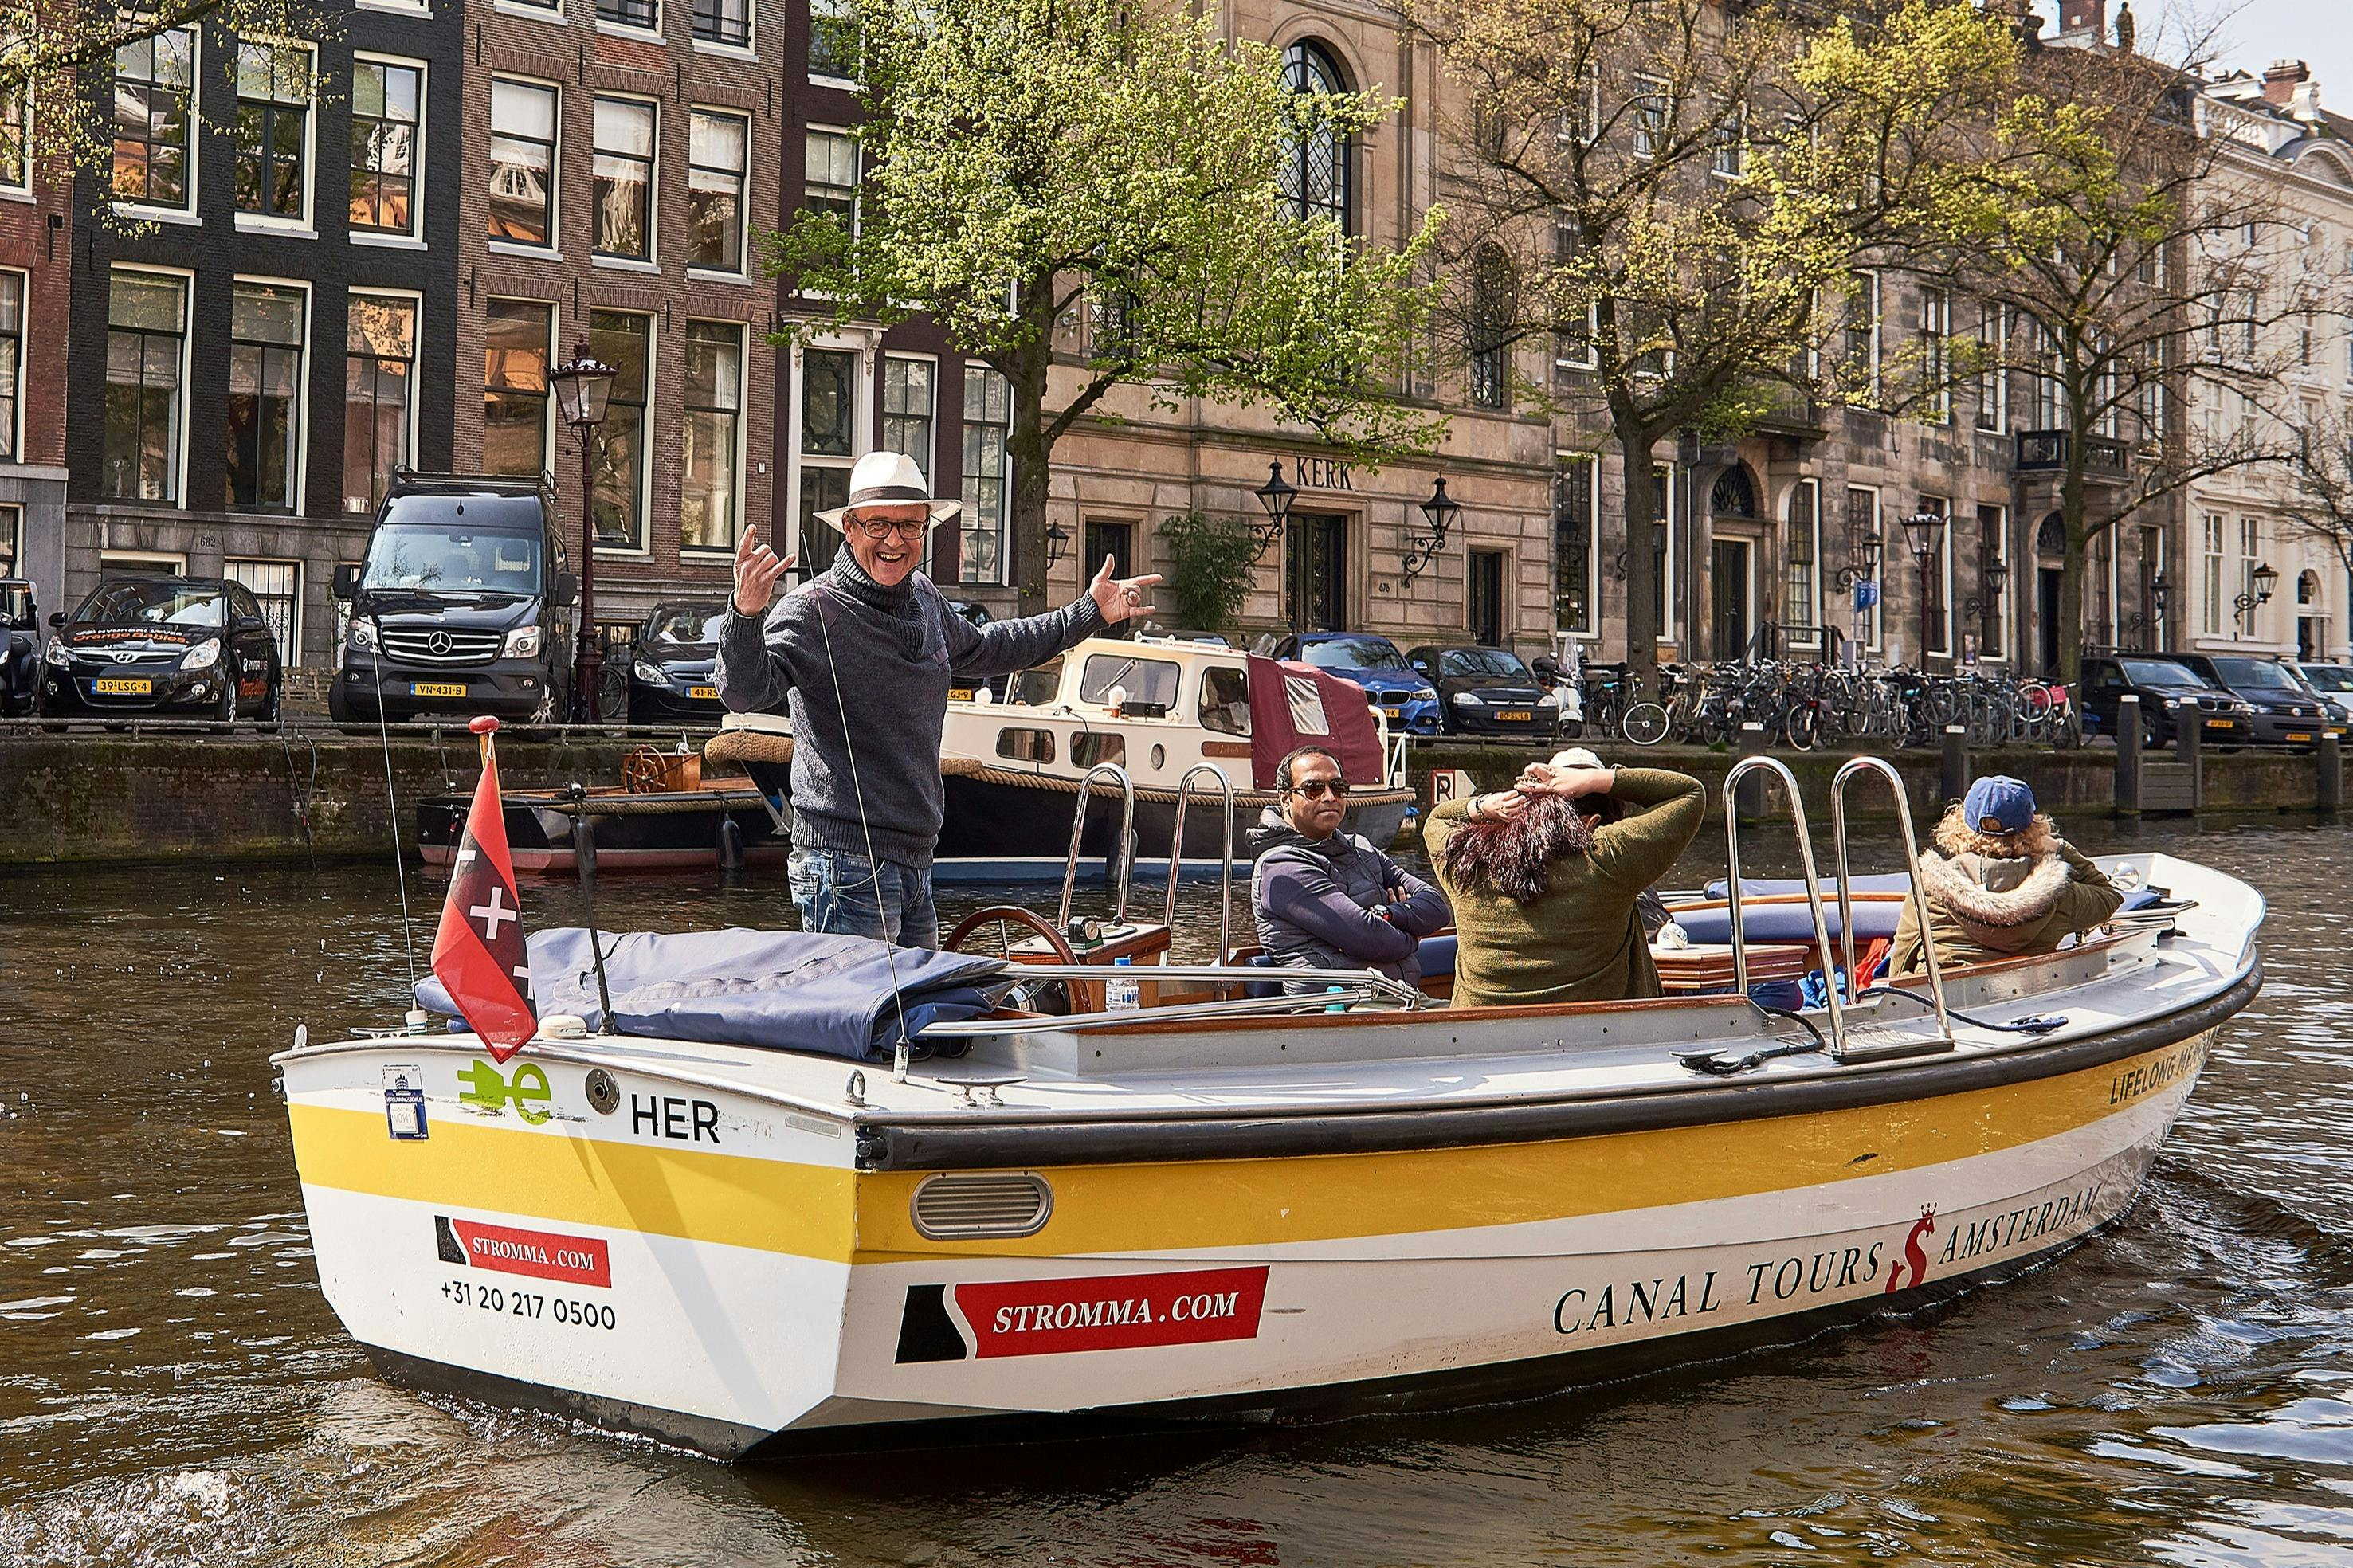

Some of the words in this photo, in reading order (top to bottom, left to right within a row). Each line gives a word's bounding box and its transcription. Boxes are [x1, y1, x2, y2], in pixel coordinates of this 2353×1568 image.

[1296, 457, 1352, 491] KERK
[200, 535, 216, 547] 682
[73, 632, 131, 642] Orange
[100, 680, 147, 691] 39-LSG-4
[419, 684, 462, 696] VN-431-B
[694, 688, 719, 697] 41-RS
[950, 690, 969, 699] GJ-9
[2110, 1053, 2177, 1105] LIFELONG
[630, 1092, 721, 1144] HER
[1552, 1270, 1721, 1335] CANAL
[1746, 1240, 1884, 1305] TOURS
[1937, 1182, 2104, 1265] AMSTERDAM
[441, 1280, 471, 1307] +31
[478, 1285, 504, 1312] 20
[511, 1292, 544, 1319] 217
[553, 1298, 616, 1331] 0500
